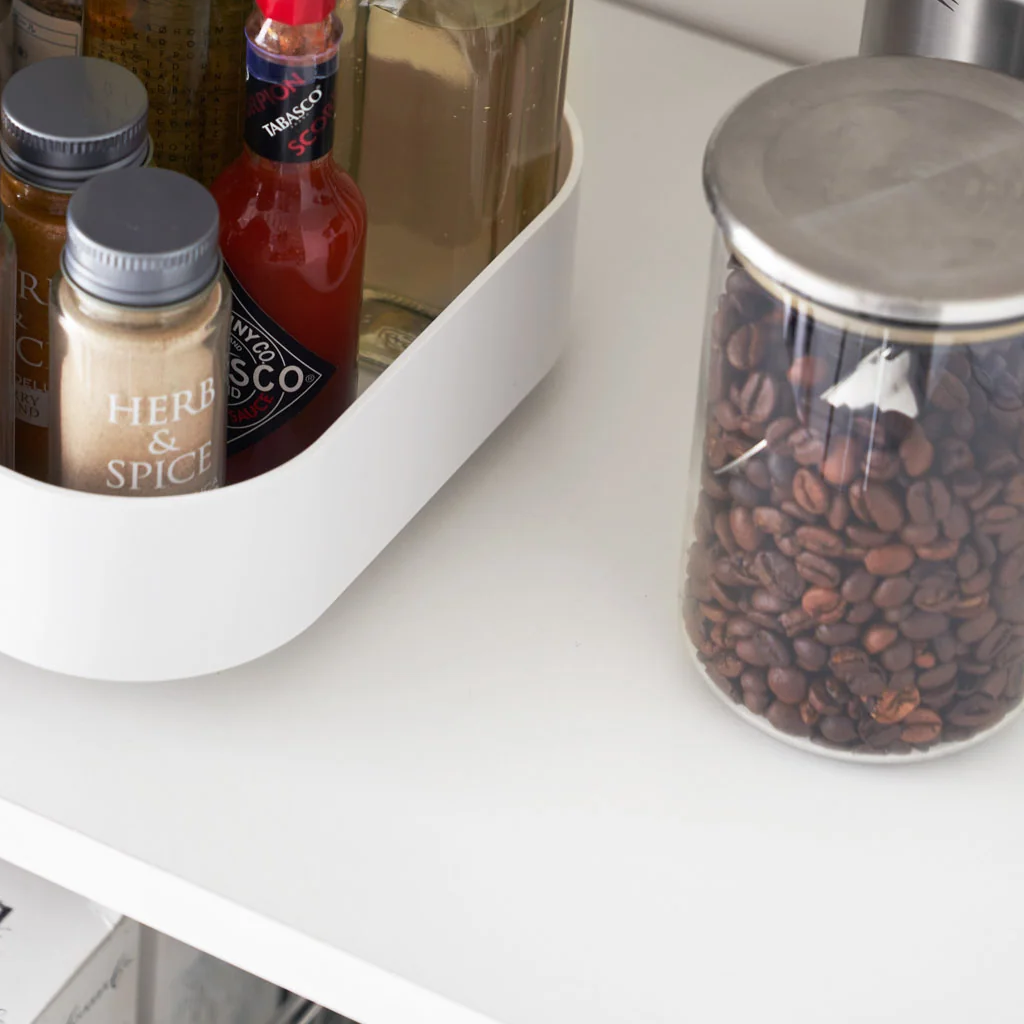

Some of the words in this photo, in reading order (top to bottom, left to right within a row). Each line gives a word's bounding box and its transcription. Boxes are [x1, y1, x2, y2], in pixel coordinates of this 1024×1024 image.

[262, 88, 323, 138] TABASCO
[107, 376, 216, 427] HERB
[105, 439, 214, 492] SPICE
[147, 428, 181, 456] &
